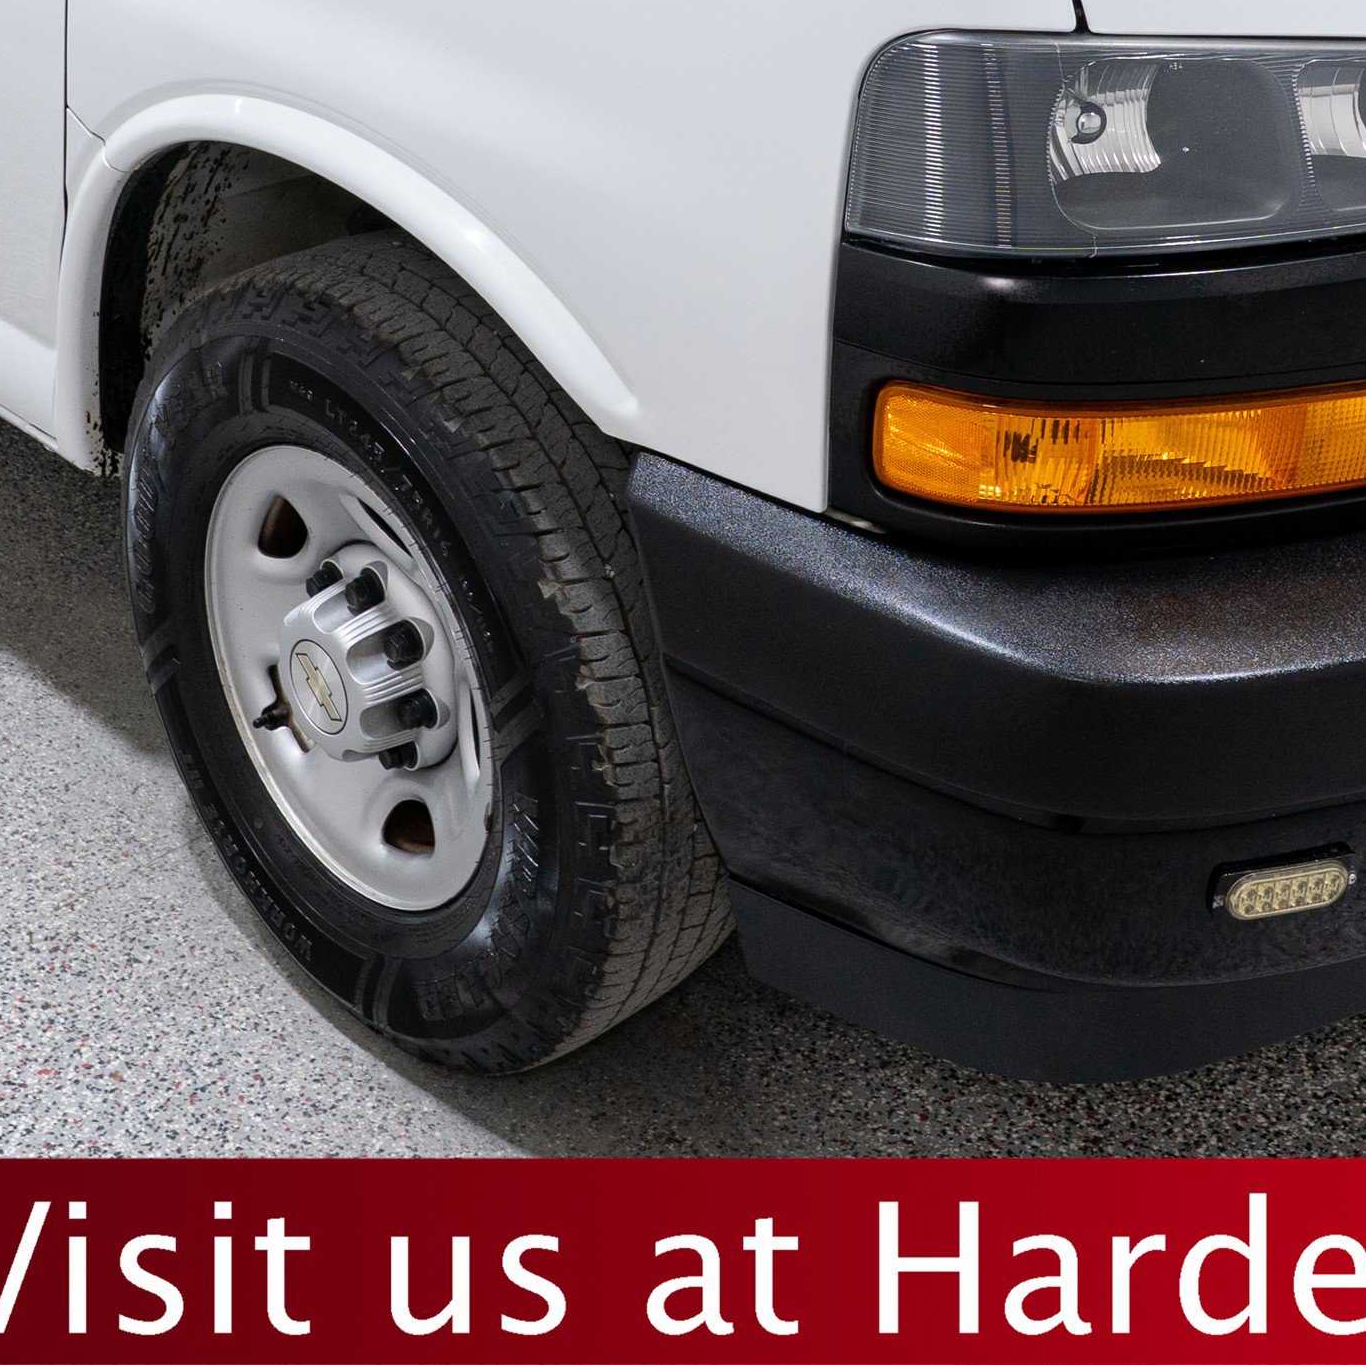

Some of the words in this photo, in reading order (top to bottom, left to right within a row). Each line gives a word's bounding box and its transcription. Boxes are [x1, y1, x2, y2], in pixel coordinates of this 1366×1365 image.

[133, 362, 229, 614] GOODYEAR
[204, 803, 313, 962] WORKHORSE
[415, 790, 540, 1021] WRANGLER
